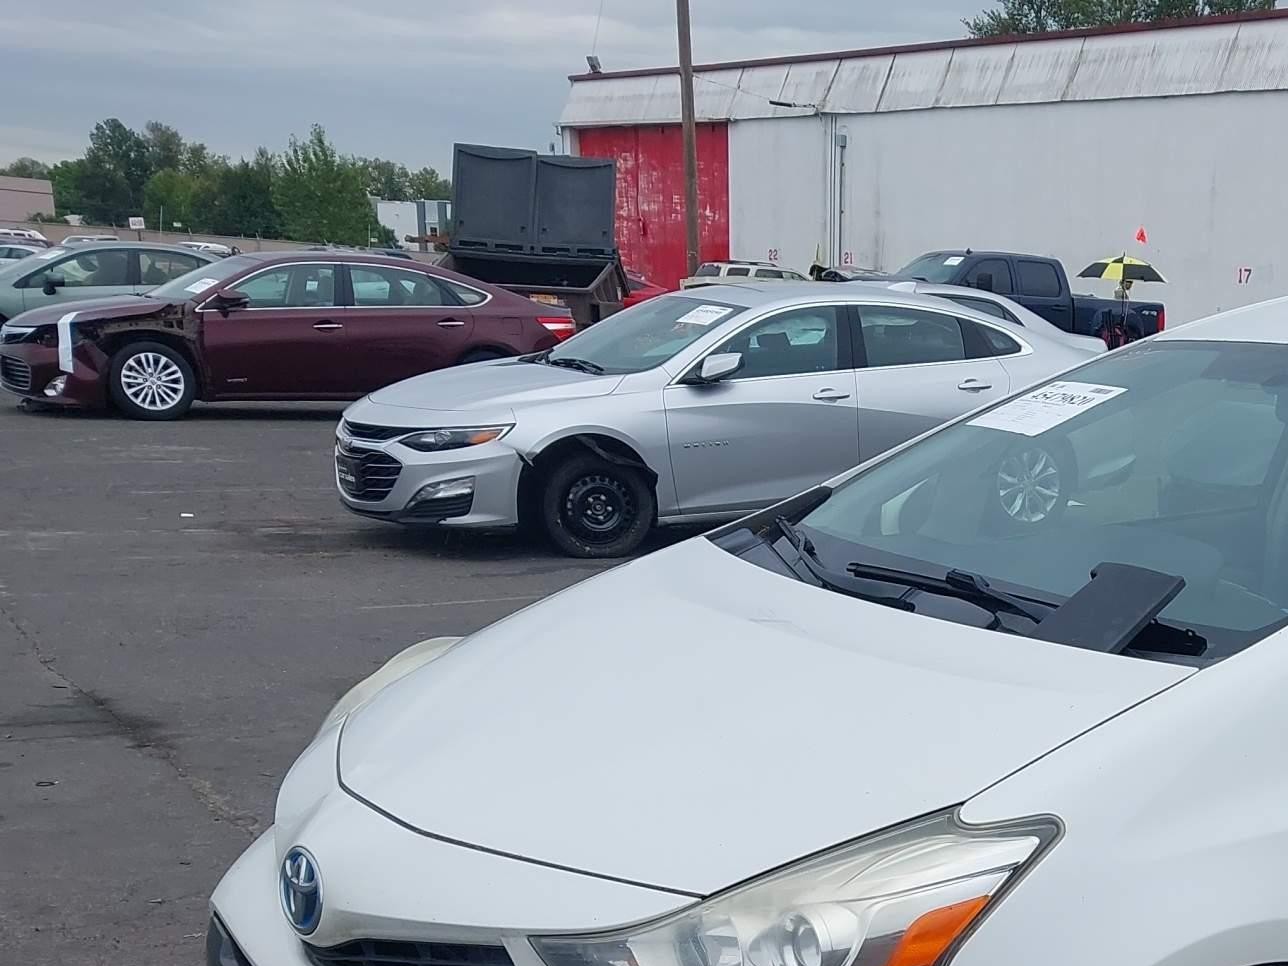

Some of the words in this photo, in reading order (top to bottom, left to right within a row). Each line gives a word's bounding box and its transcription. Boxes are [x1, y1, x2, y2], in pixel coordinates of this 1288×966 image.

[768, 249, 778, 261] 22
[843, 252, 853, 264] 21
[1238, 268, 1252, 284] 17
